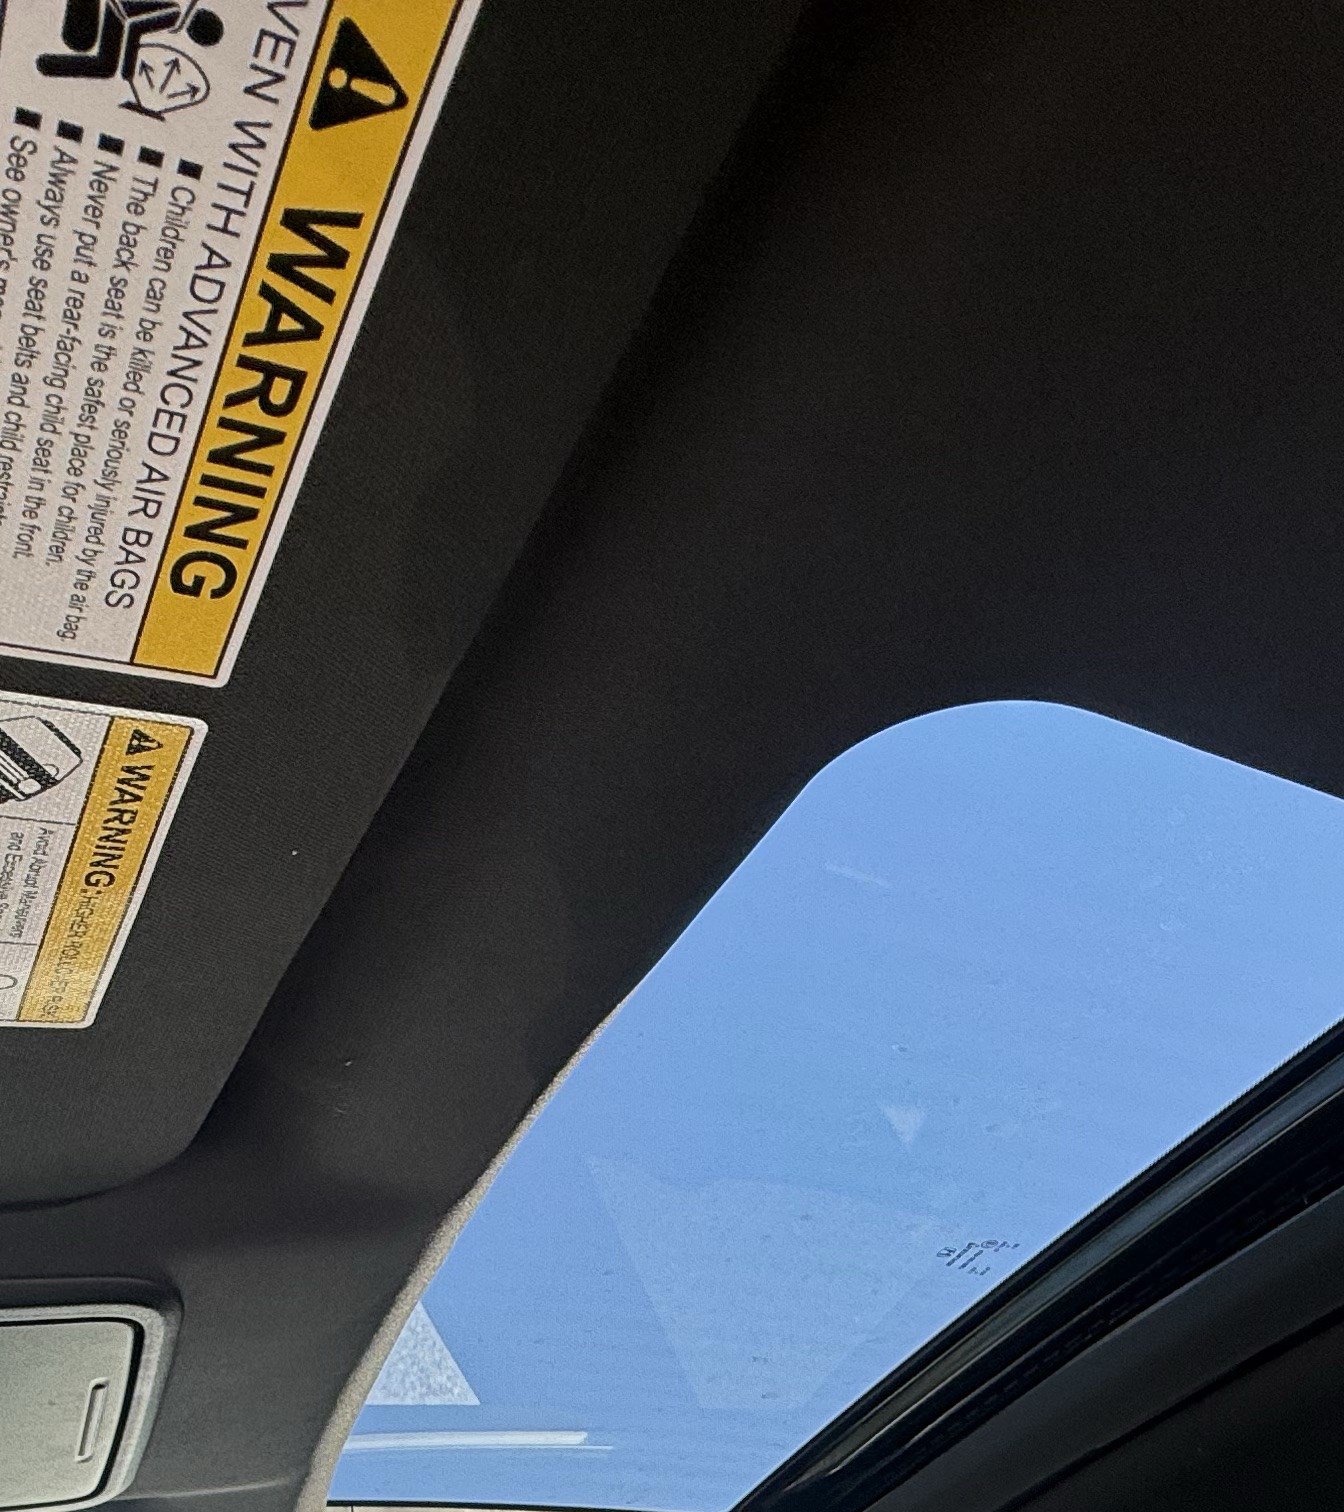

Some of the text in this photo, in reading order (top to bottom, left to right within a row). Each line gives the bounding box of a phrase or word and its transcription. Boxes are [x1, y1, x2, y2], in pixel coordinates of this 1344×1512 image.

[5, 135, 37, 182] See
[37, 145, 78, 228] Always
[206, 121, 272, 237] WITH
[32, 233, 55, 271] use
[22, 276, 47, 320] seat
[12, 160, 119, 558] Never put a rear-facing child seat in the front.
[14, 323, 44, 368] belts
[45, 177, 158, 565] The back seat is the safest place for children.
[147, 241, 231, 456] ADVANCED
[7, 372, 29, 408] and
[56, 186, 195, 641] Children can be killed or seriously injured by the air bag.
[170, 208, 363, 598] WARNING
[0, 410, 26, 452] child
[128, 461, 169, 518] AIR
[104, 527, 152, 608] BAGS
[6, 831, 25, 851] and
